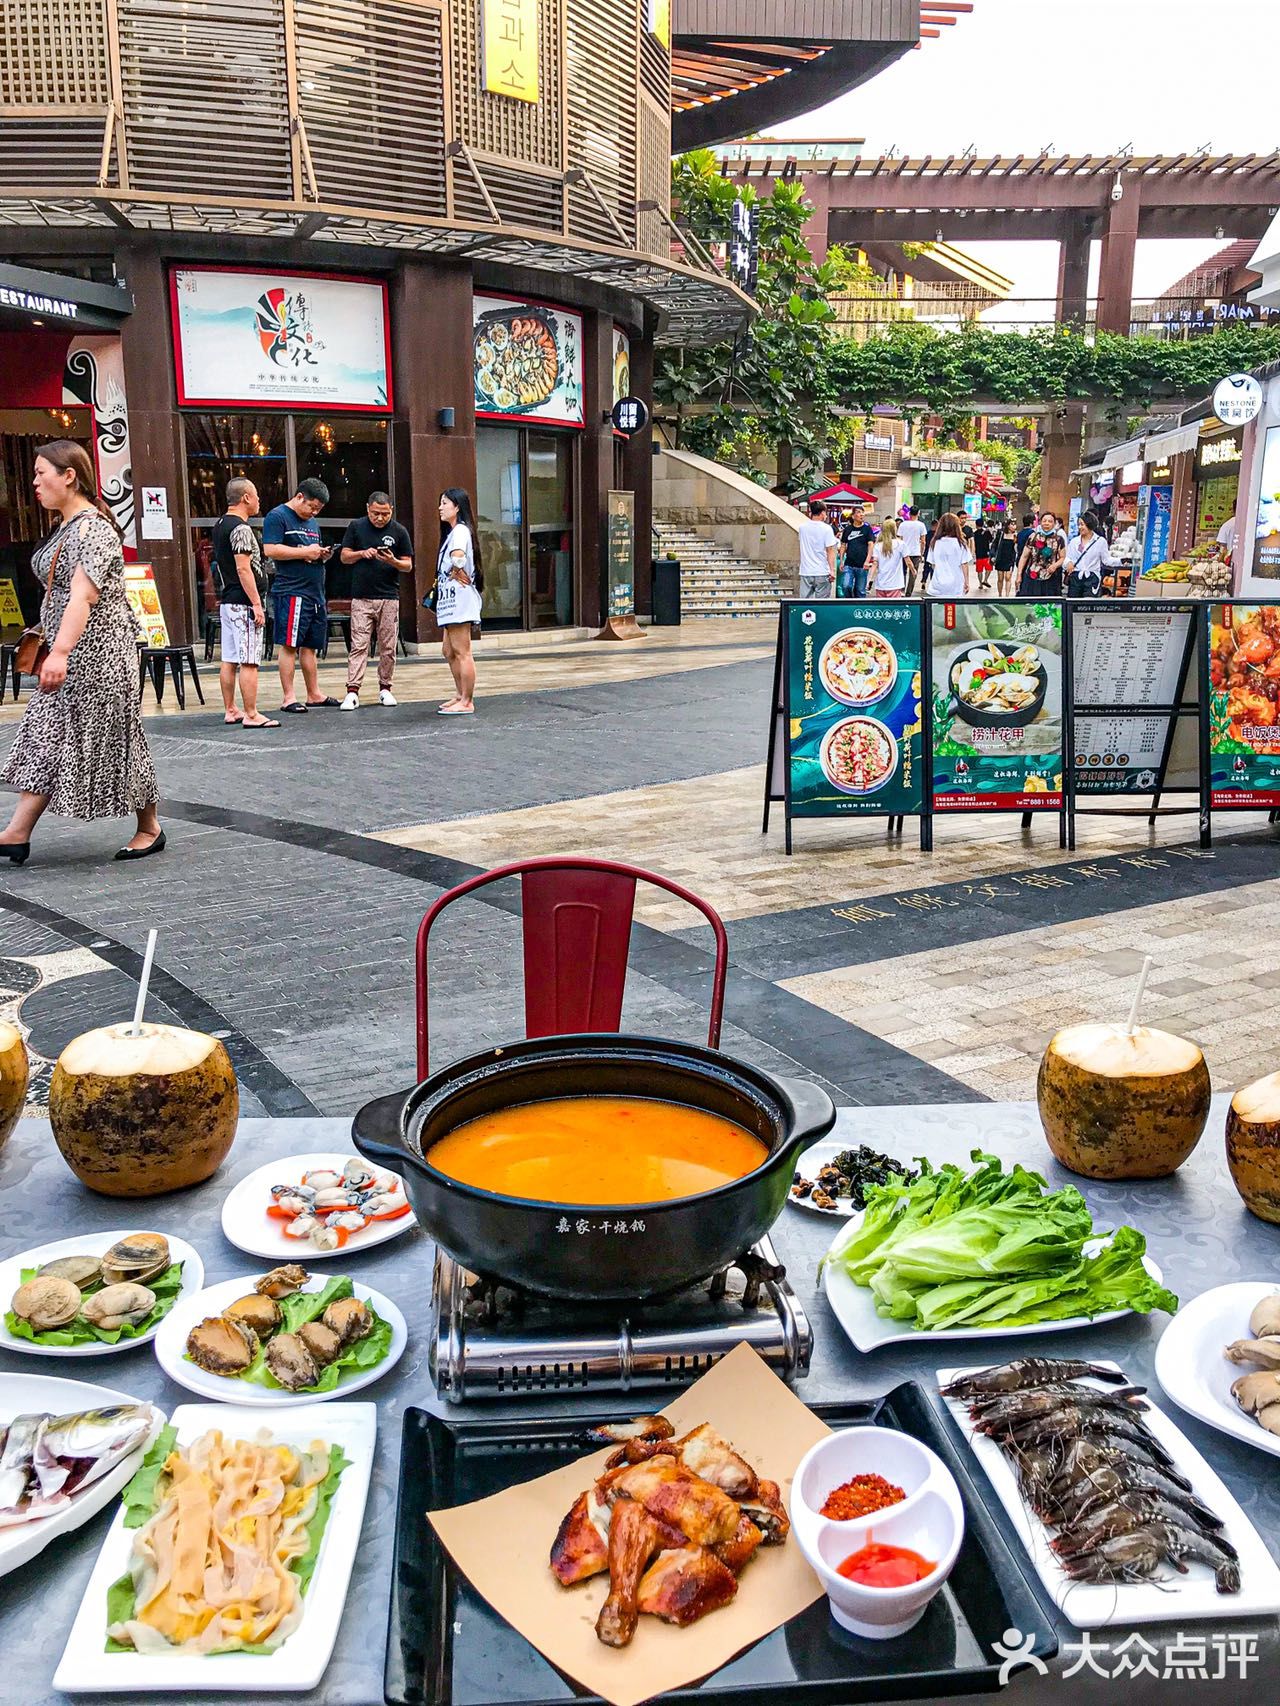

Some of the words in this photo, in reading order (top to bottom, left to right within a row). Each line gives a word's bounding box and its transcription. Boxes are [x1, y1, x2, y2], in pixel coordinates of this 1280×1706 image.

[499, 0, 526, 91] 과소
[972, 727, 1024, 741] 捞汁花甲
